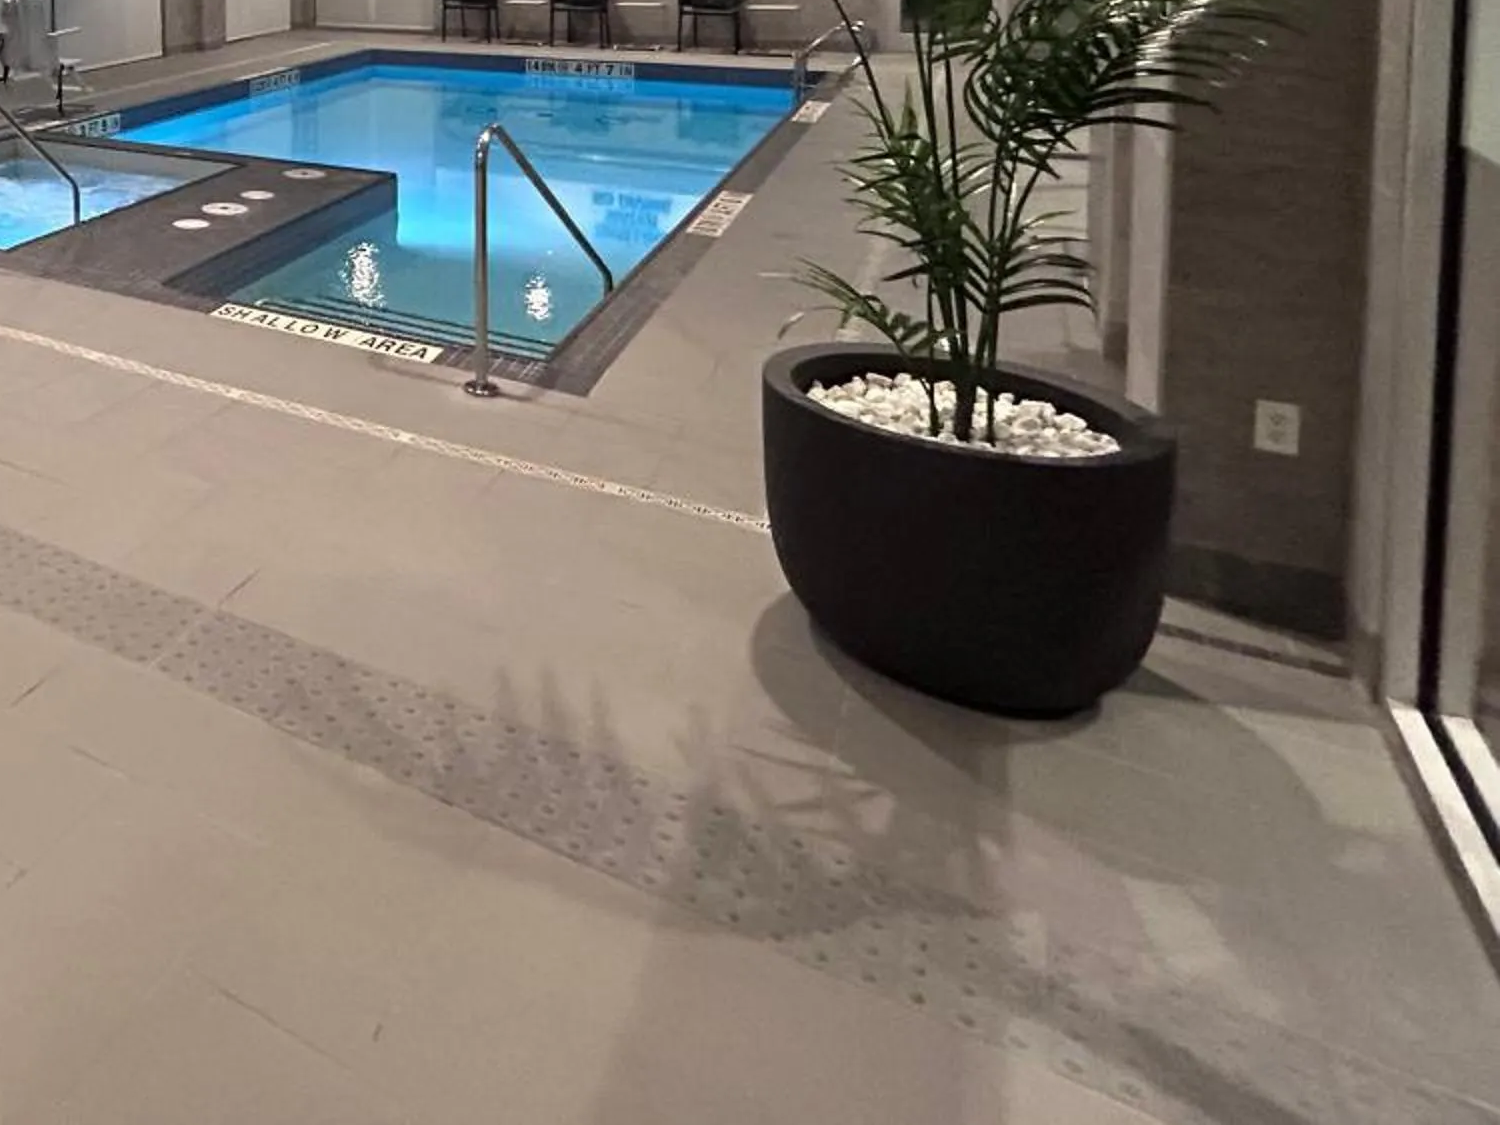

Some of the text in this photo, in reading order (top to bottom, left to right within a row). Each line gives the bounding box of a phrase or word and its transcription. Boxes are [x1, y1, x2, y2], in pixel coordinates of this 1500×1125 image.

[605, 64, 615, 76] 7
[218, 306, 430, 360] SHALLOW AREA
